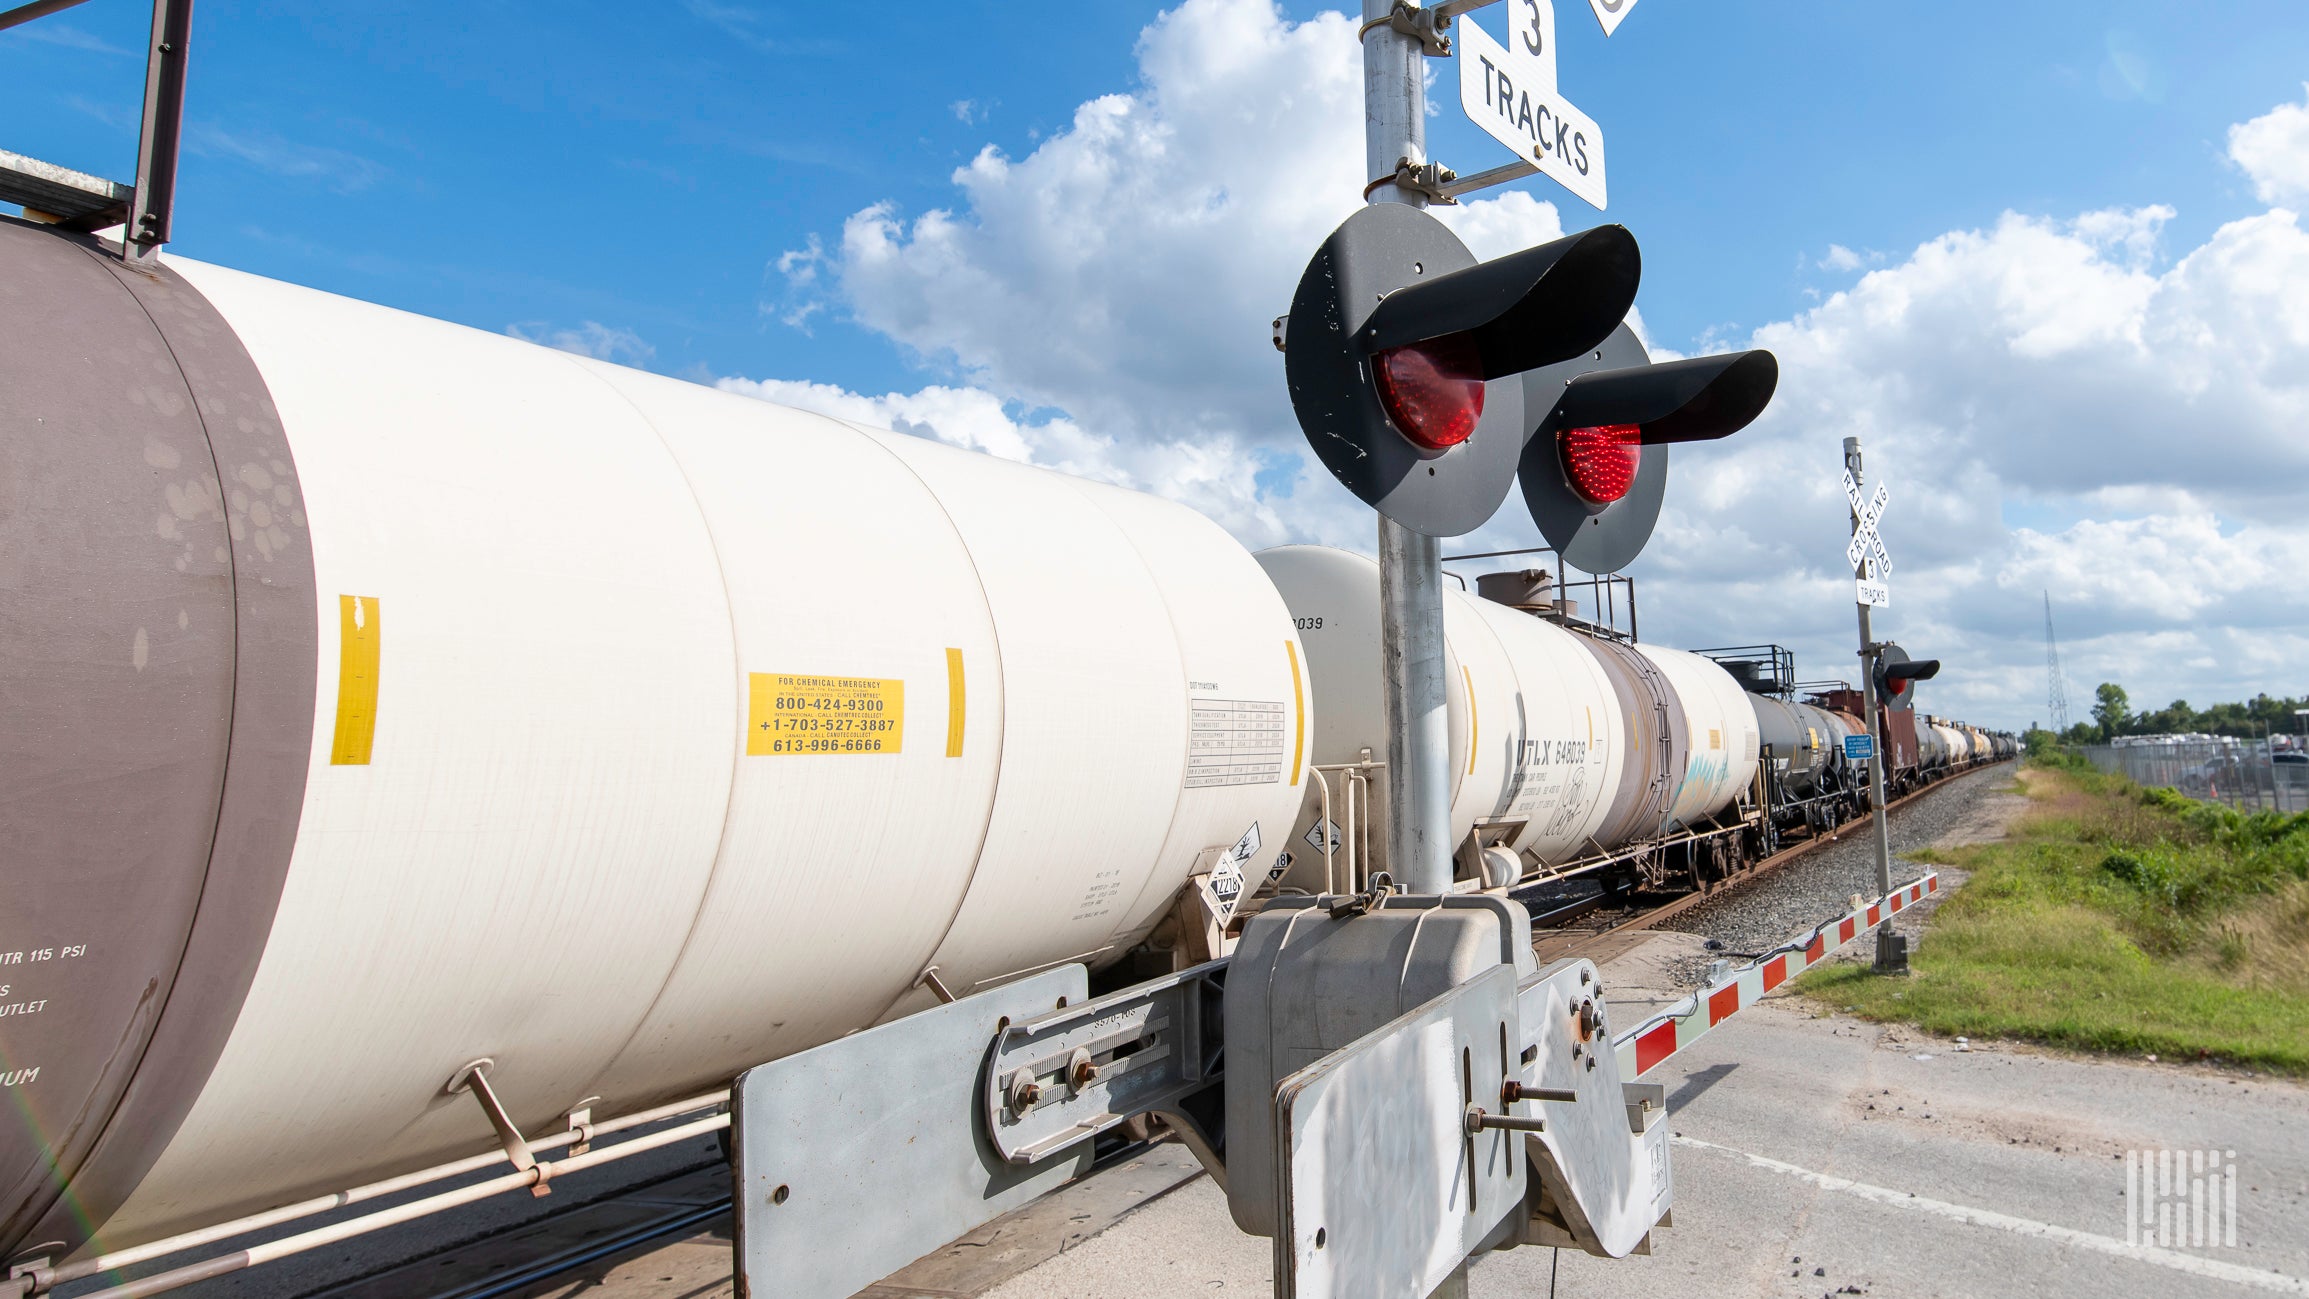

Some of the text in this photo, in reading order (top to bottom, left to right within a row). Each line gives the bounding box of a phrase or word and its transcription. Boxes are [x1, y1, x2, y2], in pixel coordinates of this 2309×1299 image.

[1522, 0, 1543, 56] 3
[1480, 54, 1589, 176] TRACKS
[1844, 474, 1890, 574] RAIL ROAD
[1850, 487, 1887, 564] CROSSING
[1868, 559, 1875, 579] 3
[1861, 586, 1886, 602] TRACKS
[778, 677, 881, 689] FOR CHEMICAL EMERGENCY
[775, 697, 884, 711] 800-424-9300
[773, 739, 882, 752] 613-996-6666
[1516, 739, 1586, 766] UTLX 648039
[1217, 877, 1238, 894] 2218
[30, 948, 53, 962] 115
[60, 944, 87, 959] PSI
